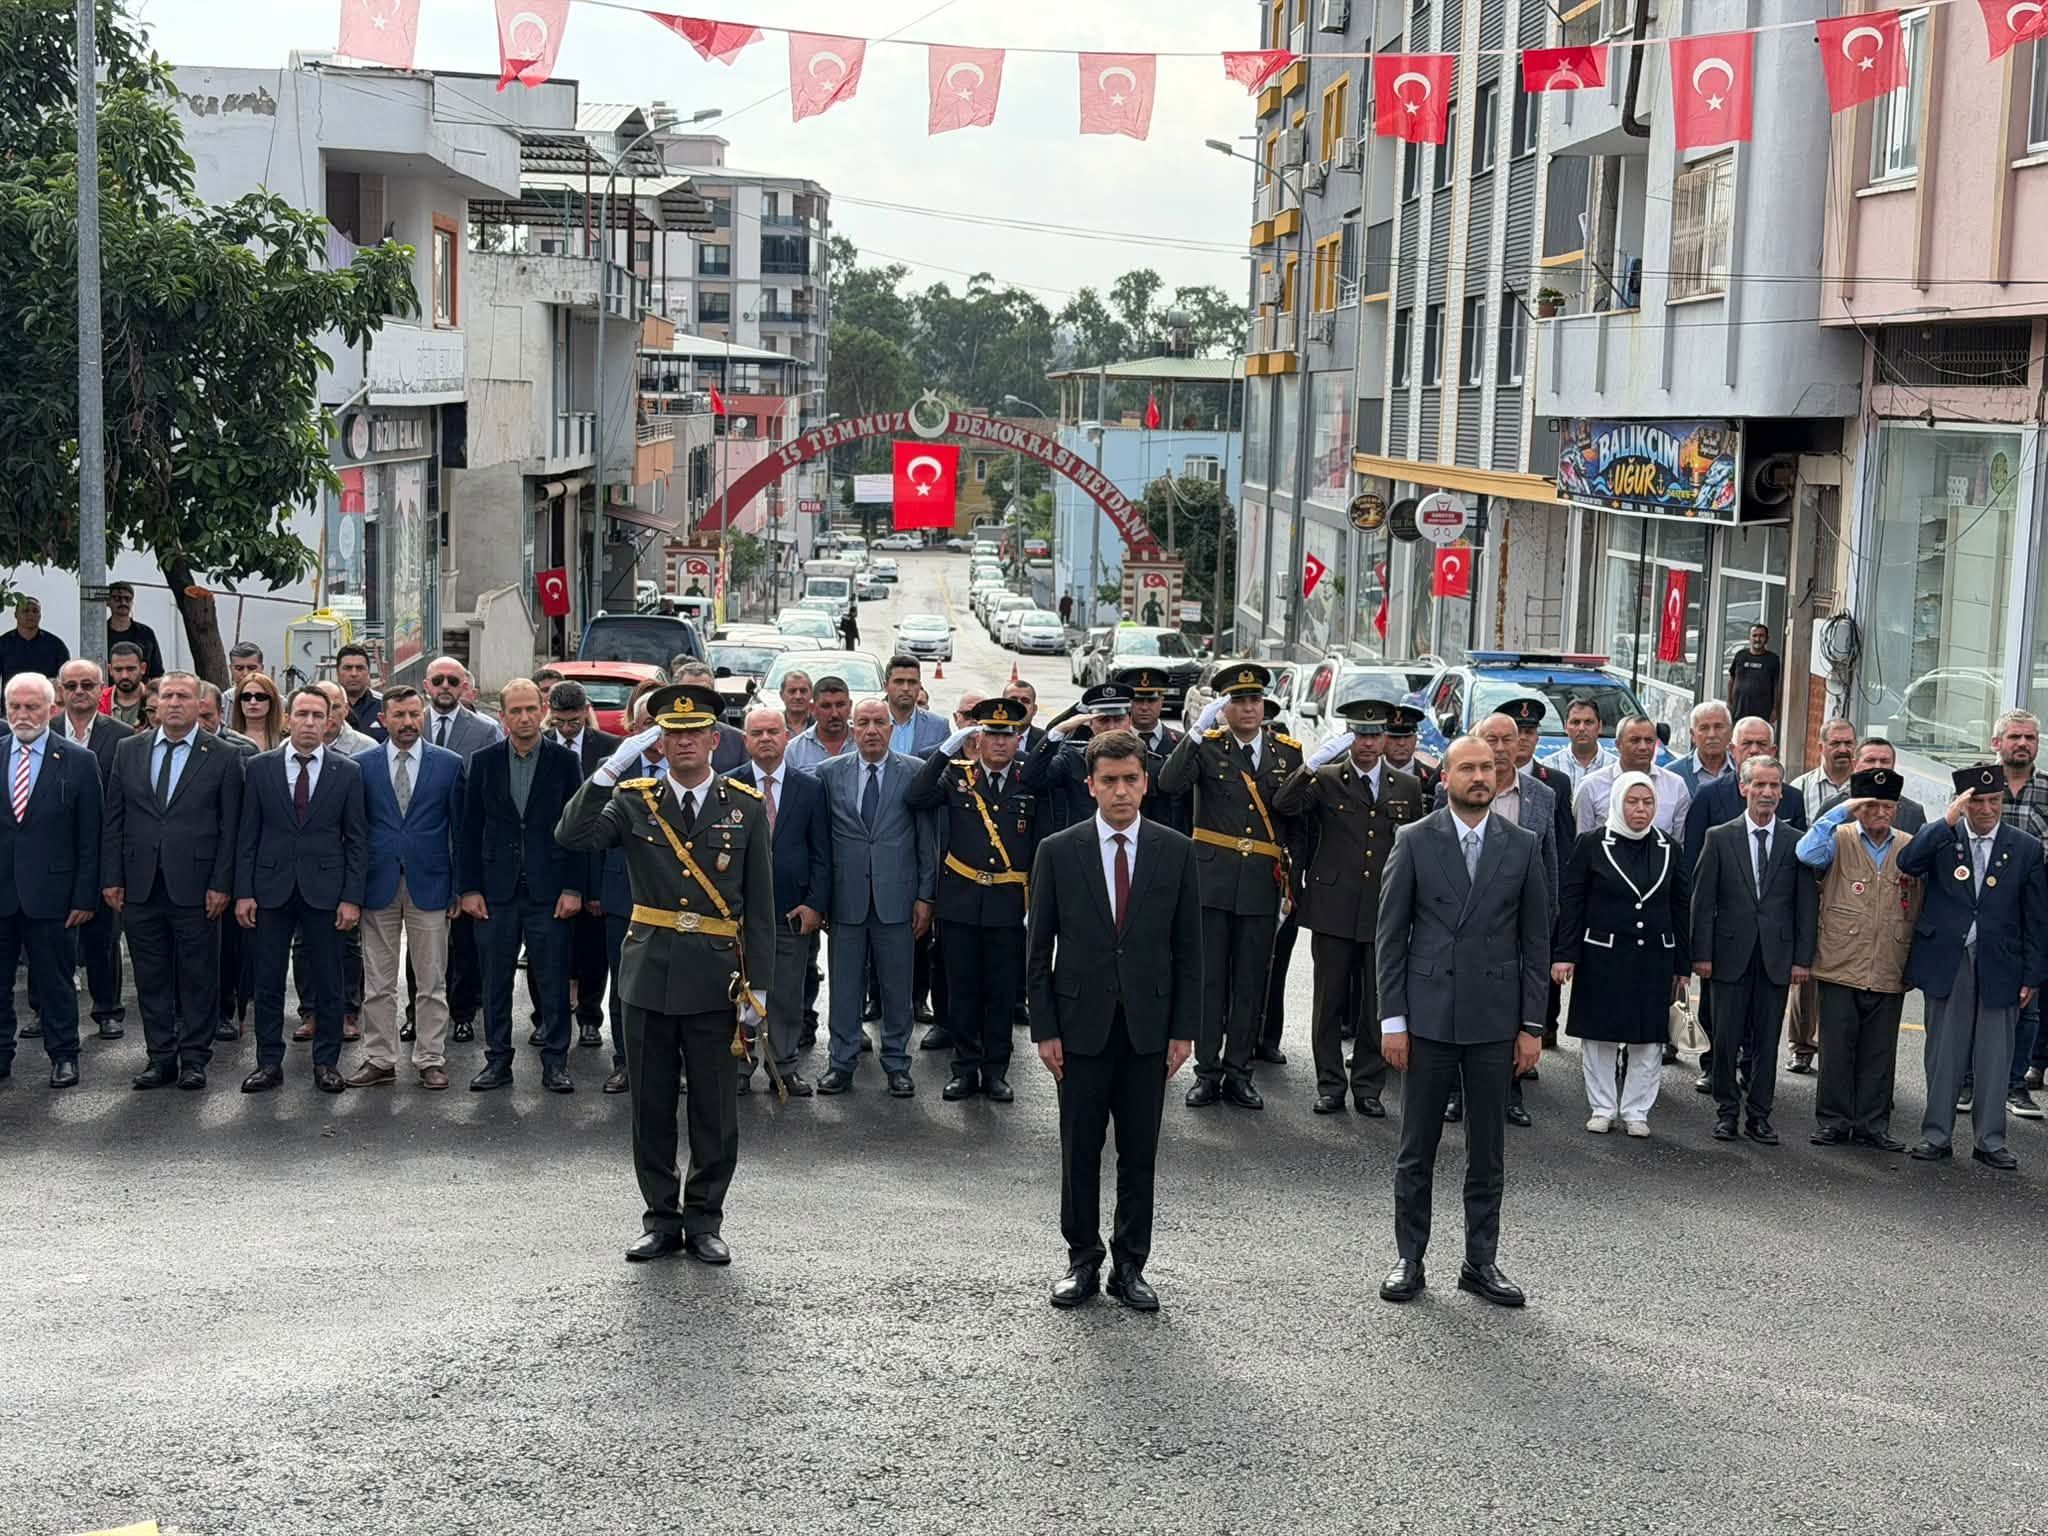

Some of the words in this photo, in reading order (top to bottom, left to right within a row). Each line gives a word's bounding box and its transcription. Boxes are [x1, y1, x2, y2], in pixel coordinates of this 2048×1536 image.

[779, 444, 802, 466] 15
[807, 412, 906, 451] TEMMUZ
[1074, 462, 1150, 542] MEYDANI
[1599, 424, 1681, 478] BALIKÇIM
[1614, 457, 1658, 497] UĞUR
